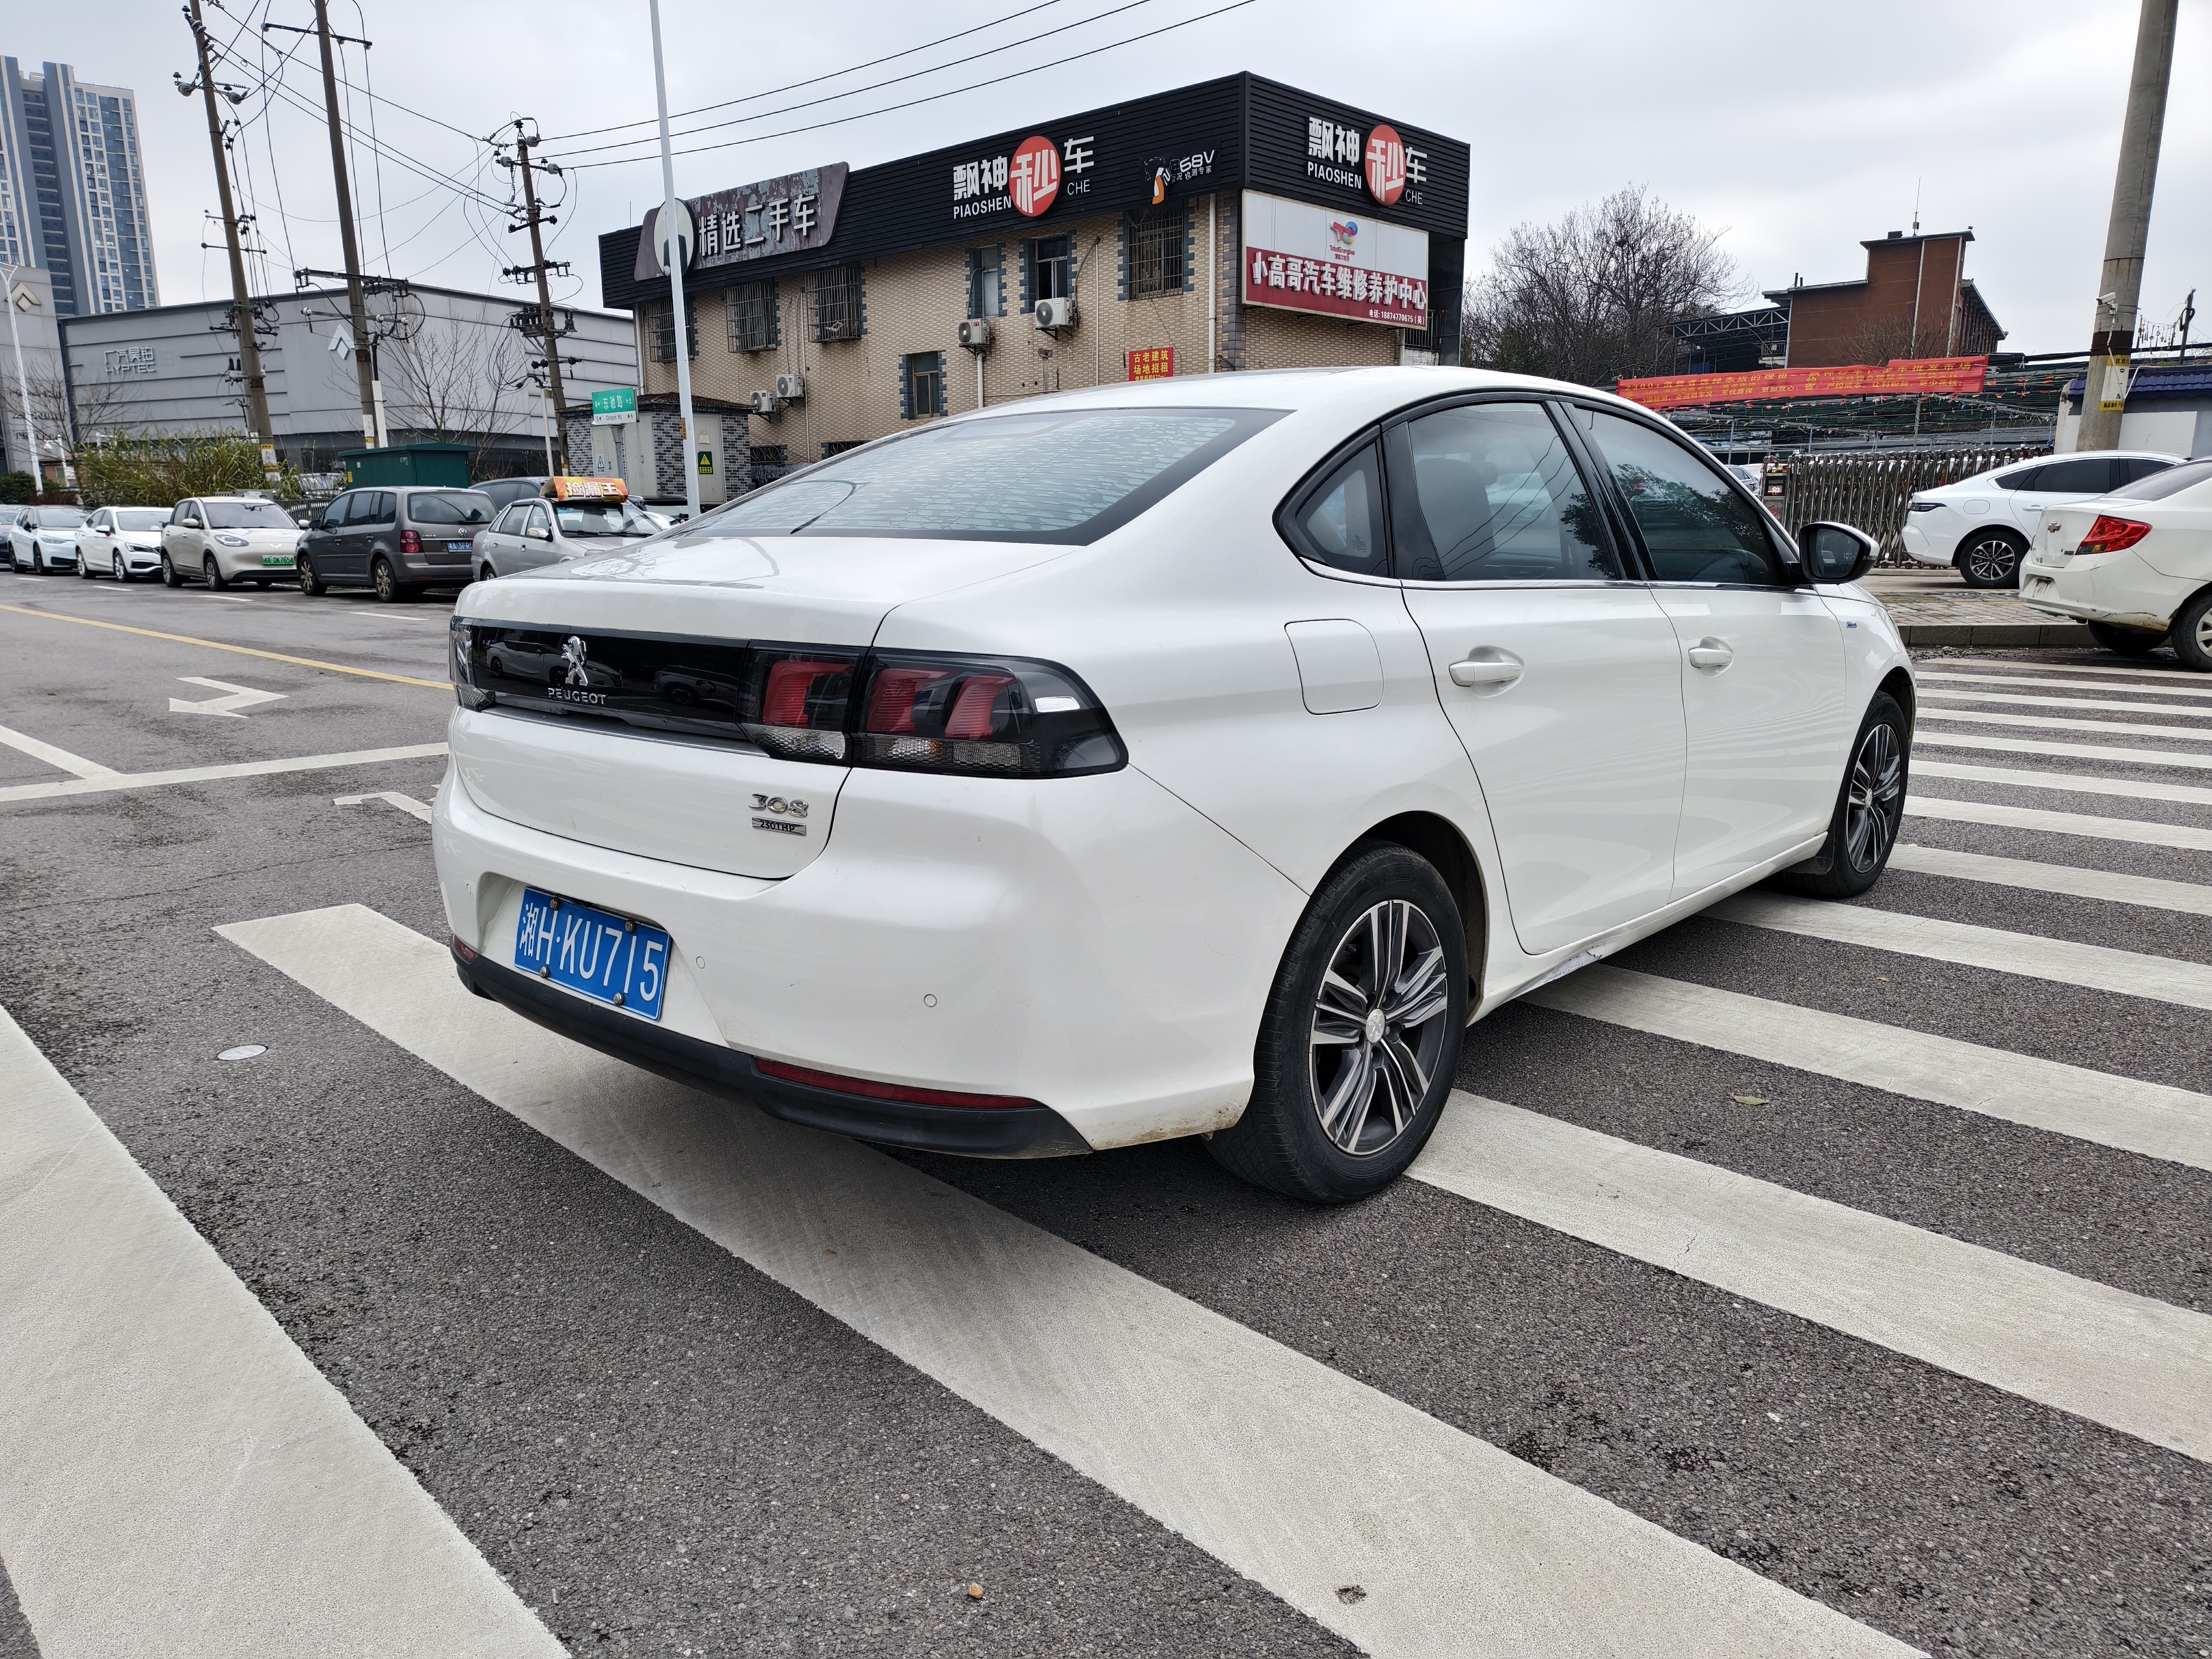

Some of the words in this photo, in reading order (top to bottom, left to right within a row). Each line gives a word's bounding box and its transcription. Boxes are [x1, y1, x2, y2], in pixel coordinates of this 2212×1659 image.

[1308, 161, 1361, 189] PIAOSHEN
[1406, 190, 1422, 205] CHE
[954, 195, 1011, 219] PIAOSHEN
[1067, 179, 1090, 195] CHE
[699, 193, 815, 257] 精选二手车
[1252, 252, 1427, 310] 小高哥汽车维修养护中心
[1134, 349, 1169, 363] 古老建筑
[106, 362, 157, 375] HYPTEC
[1134, 362, 1168, 375] 场地招租
[565, 481, 619, 497] 捡漏王
[548, 687, 606, 705] PEUGEOT
[748, 793, 808, 818] 308
[760, 820, 795, 832] 230THP
